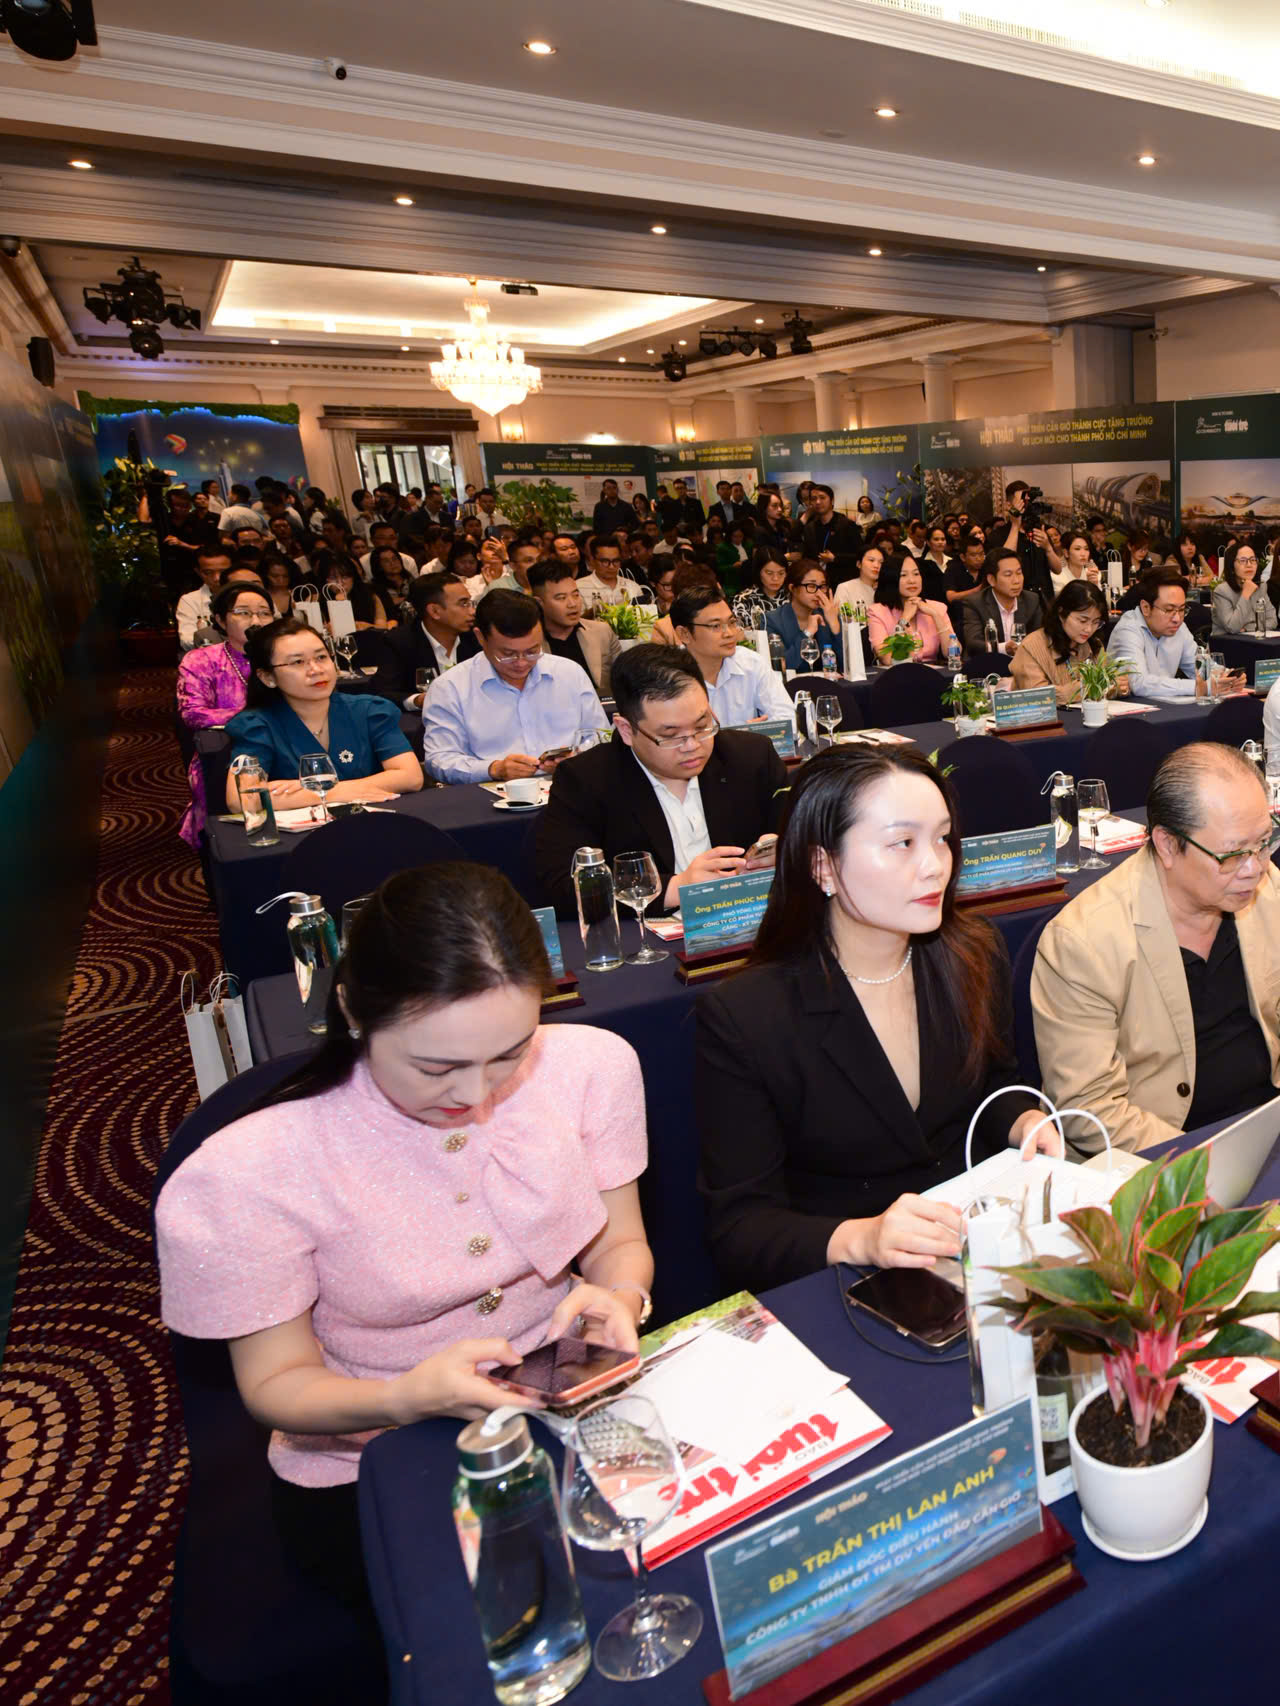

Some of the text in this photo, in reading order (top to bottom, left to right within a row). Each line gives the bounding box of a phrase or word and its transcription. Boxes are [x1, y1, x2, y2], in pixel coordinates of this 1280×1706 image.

[1001, 850, 1027, 861] QUANG
[1028, 847, 1043, 856] DUY
[769, 1568, 798, 1593] Bà
[867, 1512, 902, 1540] THỊ
[907, 1489, 947, 1521] LAN
[952, 1466, 996, 1499] ANH
[745, 1616, 789, 1646] CÔNG
[790, 1604, 808, 1622] TY
